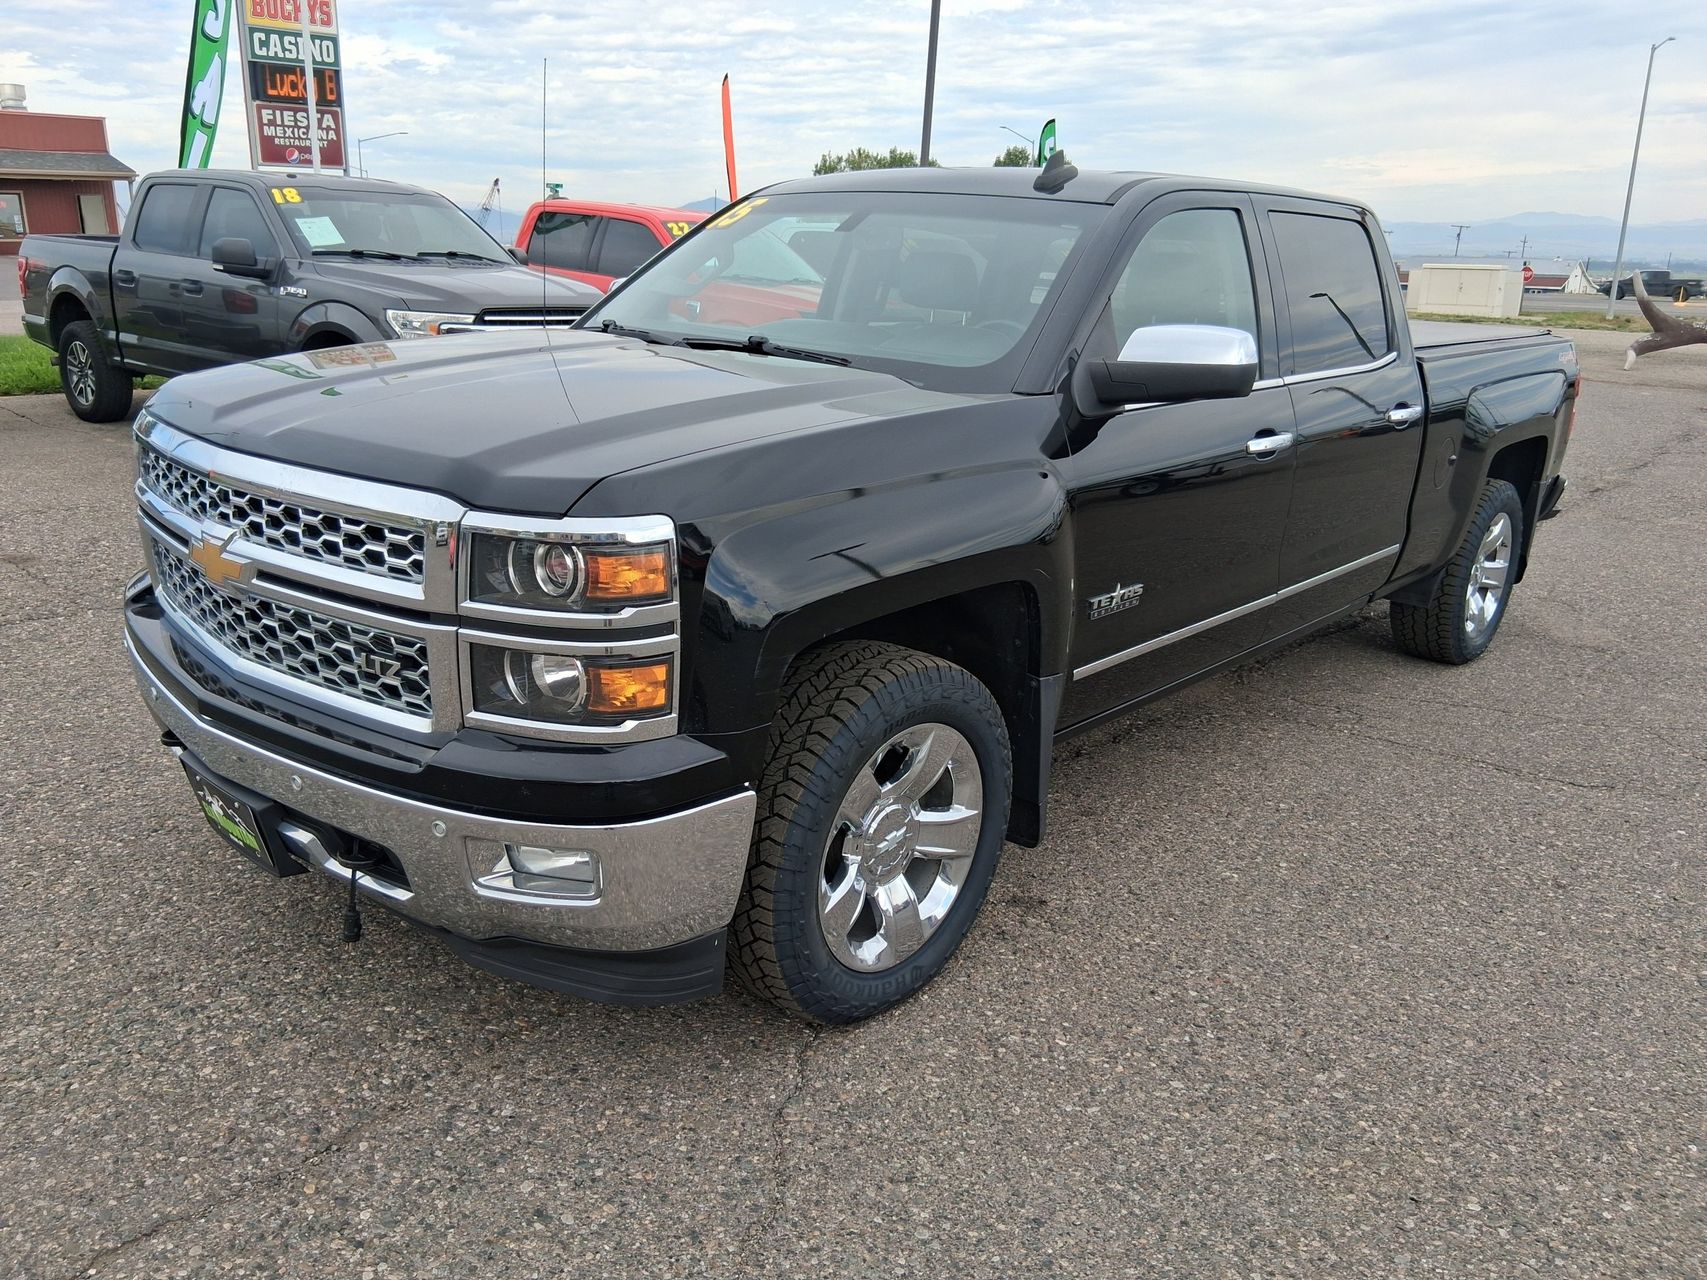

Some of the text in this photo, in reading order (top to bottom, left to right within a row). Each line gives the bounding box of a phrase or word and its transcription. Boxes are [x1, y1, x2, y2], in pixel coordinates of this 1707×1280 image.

[325, 70, 337, 100] B
[263, 126, 337, 140] MEXICNA
[274, 138, 328, 148] RESTAURNT
[271, 188, 302, 204] 18
[667, 222, 690, 236] 22
[1089, 582, 1144, 610] TEXAS
[360, 652, 402, 682] LTZ
